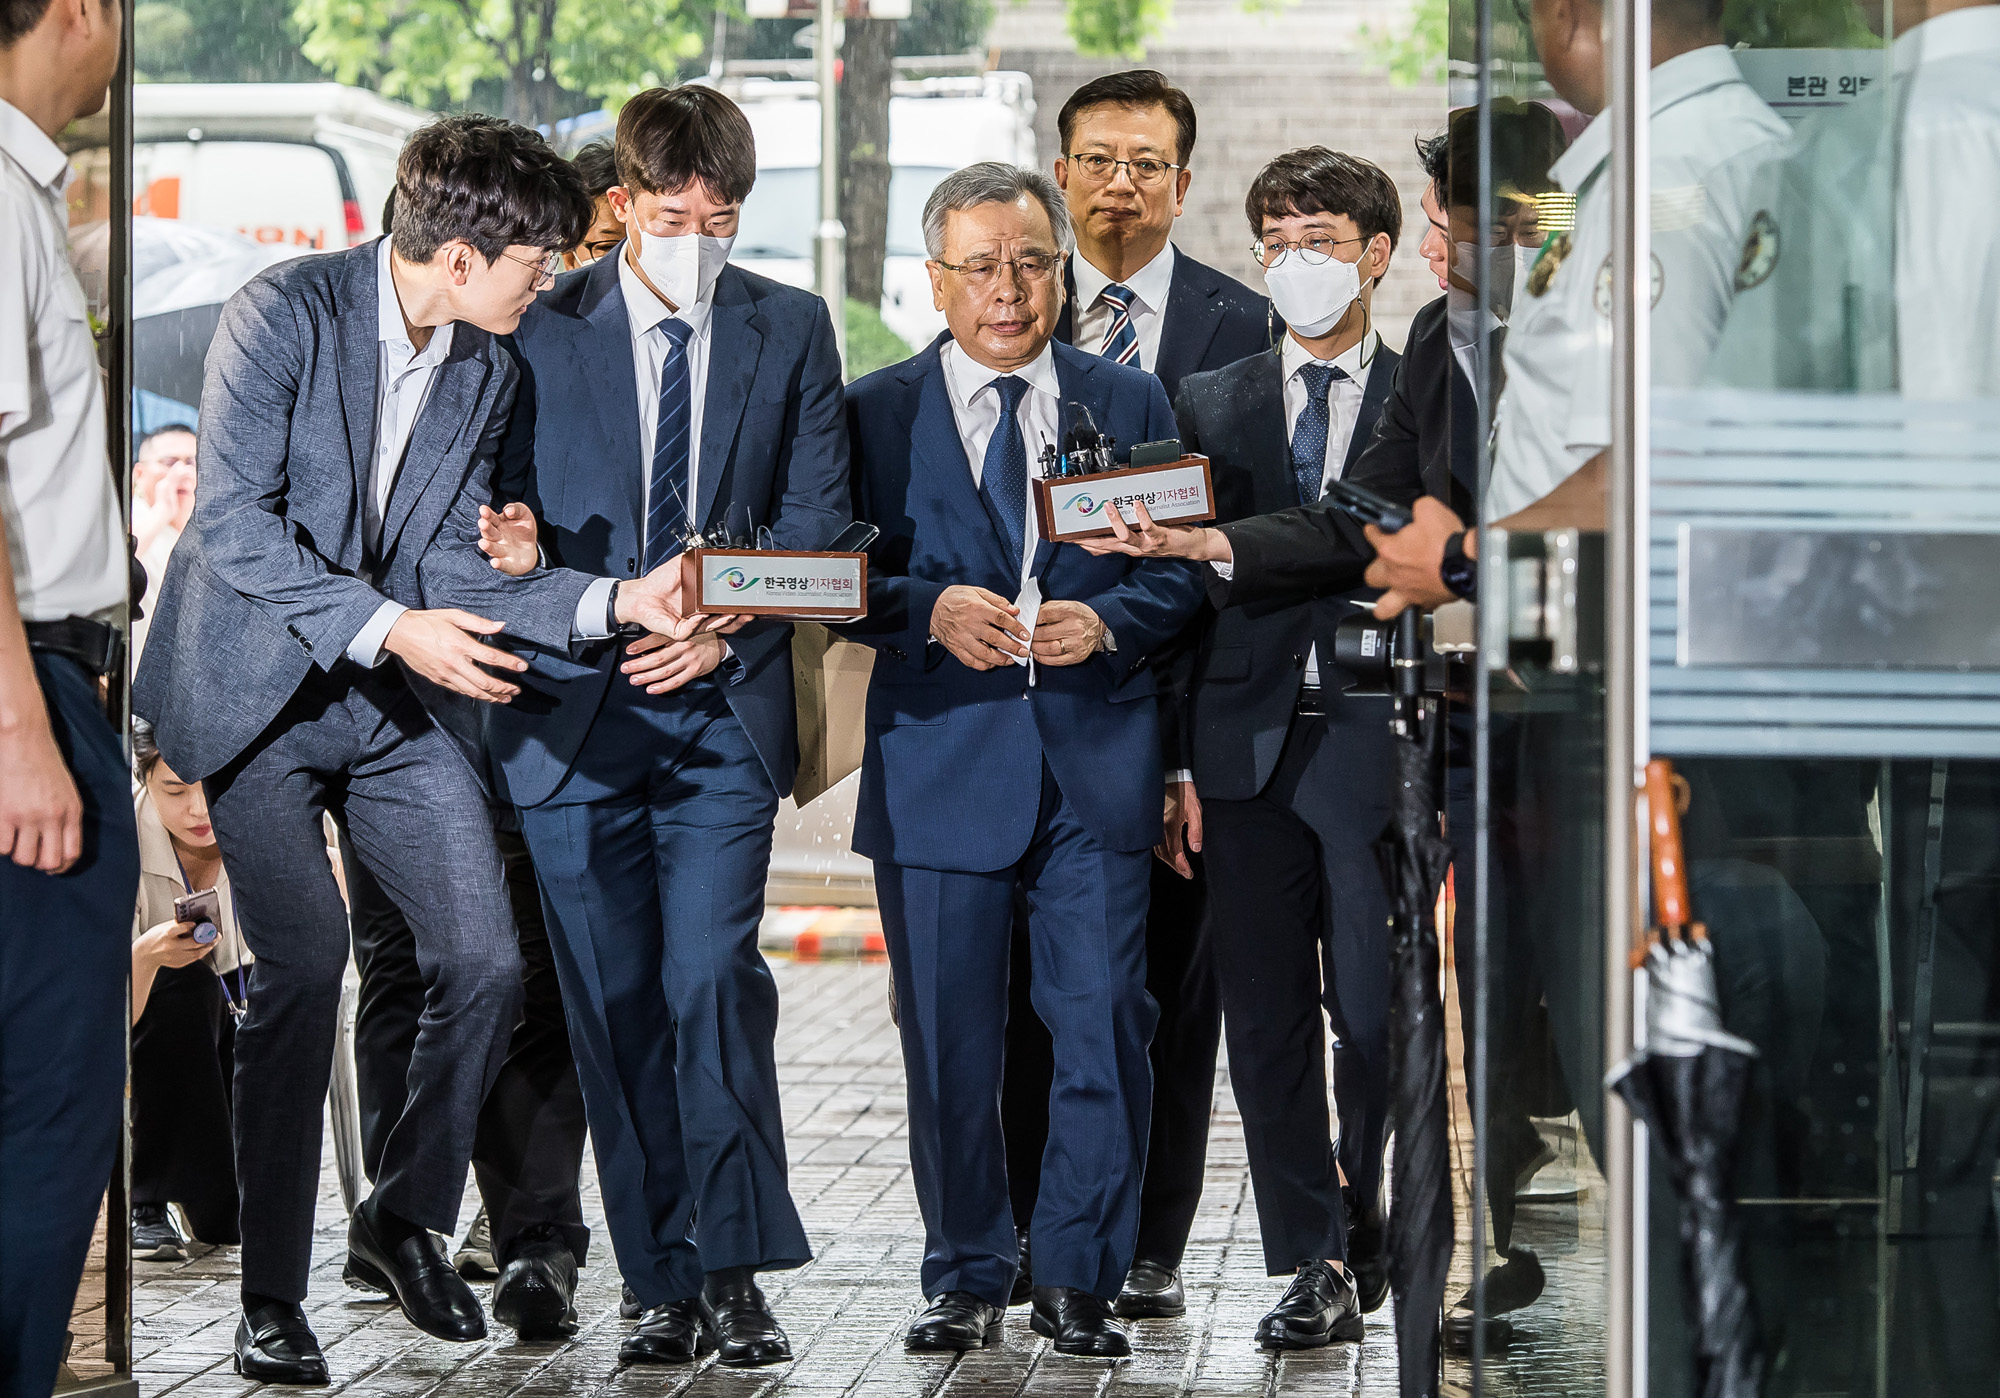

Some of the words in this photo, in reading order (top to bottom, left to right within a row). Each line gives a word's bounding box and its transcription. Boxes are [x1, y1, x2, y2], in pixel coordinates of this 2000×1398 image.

[1787, 76, 1828, 97] 본관
[1113, 486, 1199, 508] 한국영상기자협회
[1171, 500, 1200, 508] Association
[764, 577, 853, 591] 한국영상기자협회
